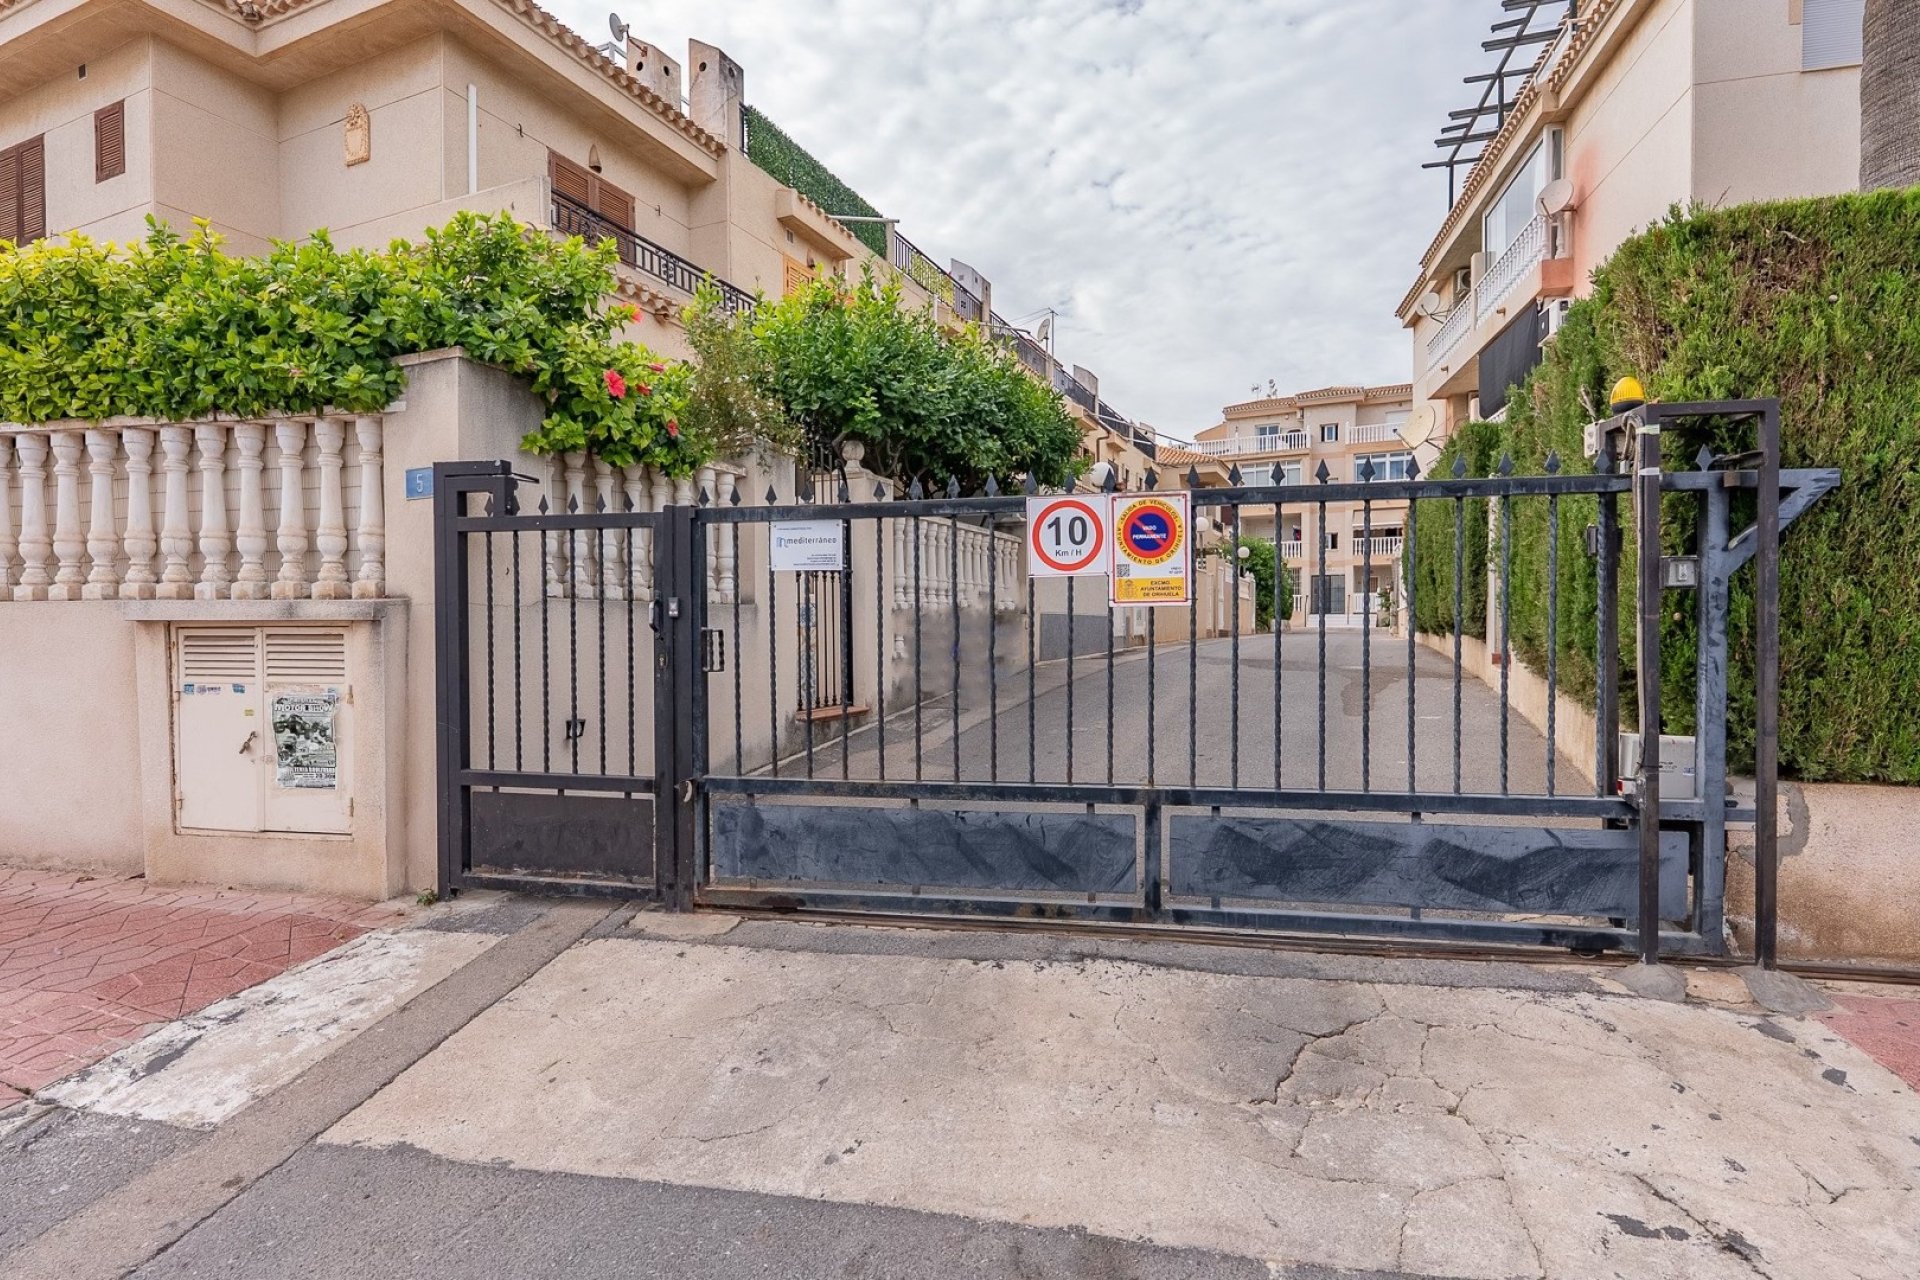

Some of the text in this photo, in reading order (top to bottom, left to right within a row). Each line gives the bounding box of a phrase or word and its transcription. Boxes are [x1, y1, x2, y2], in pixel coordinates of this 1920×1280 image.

[416, 473, 424, 493] 5
[1120, 503, 1137, 521] SALIDA
[1150, 499, 1178, 519] VEHICULOS
[1047, 516, 1088, 546] 10
[1055, 549, 1069, 557] Km
[1117, 527, 1153, 565] AYUNTAMIENTO
[1166, 525, 1182, 558] ORIHUELA
